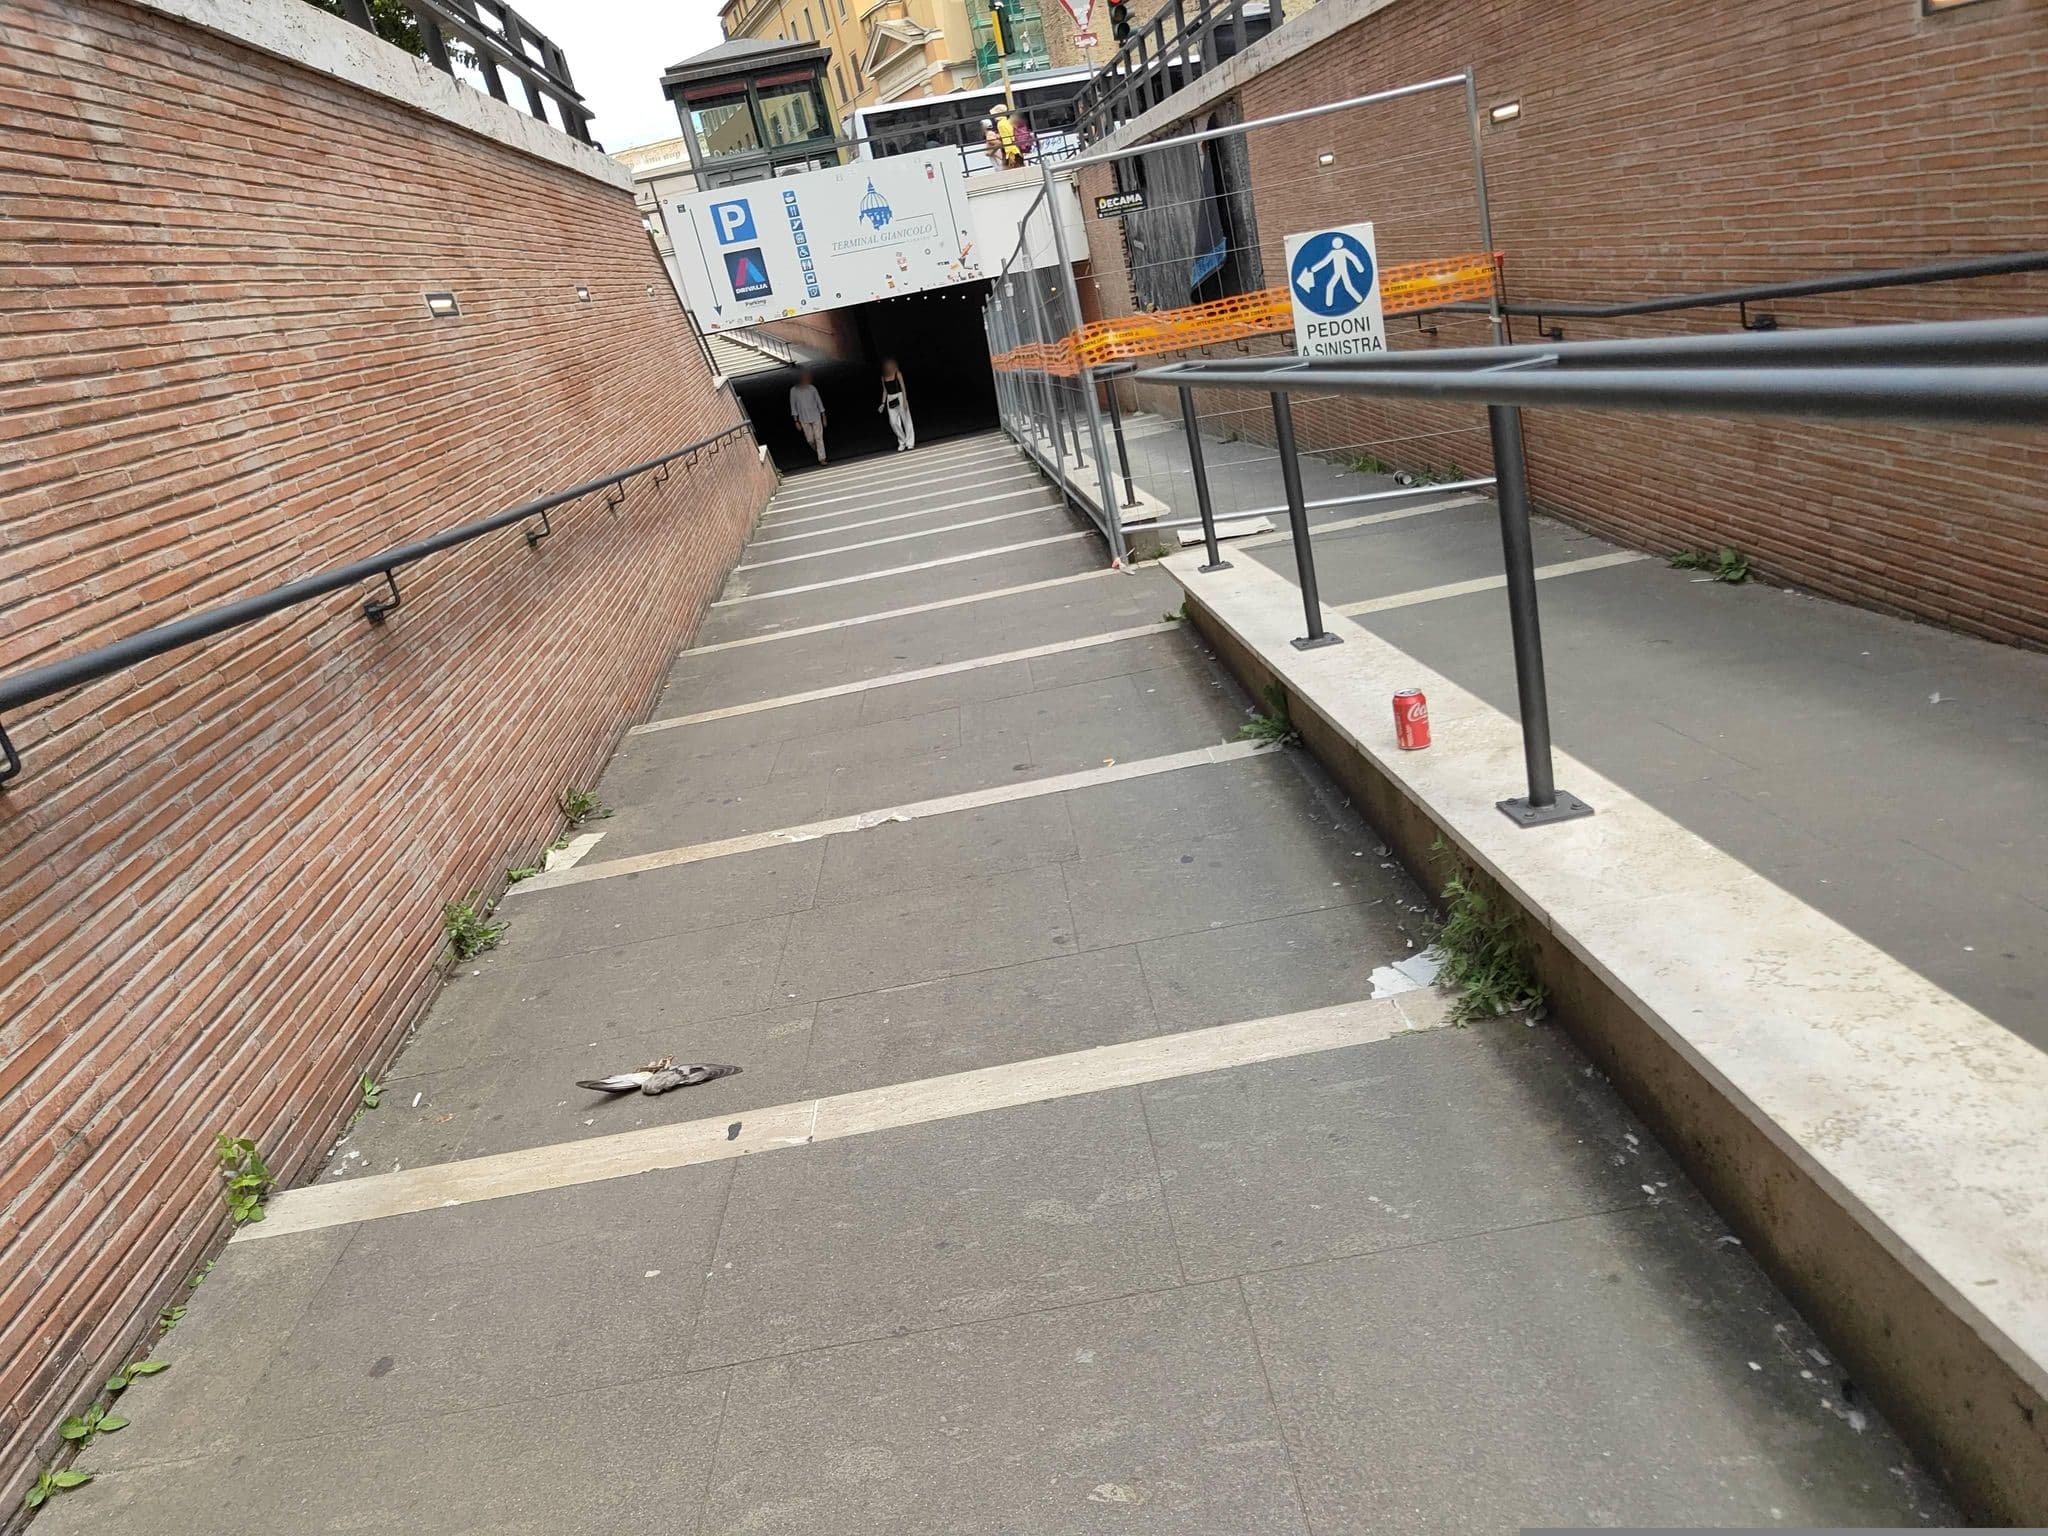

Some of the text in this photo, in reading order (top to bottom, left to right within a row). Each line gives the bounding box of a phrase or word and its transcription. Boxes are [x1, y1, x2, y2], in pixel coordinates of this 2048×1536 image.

[1098, 193, 1143, 210] DECAMA
[718, 204, 746, 241] P
[832, 235, 880, 251] TERMINAL
[880, 224, 933, 241] GIANICOLO
[735, 283, 768, 295] DRIVALIA
[745, 299, 767, 307] Parking
[1307, 316, 1371, 339] PEDONI
[1303, 335, 1383, 357] A SINISTRA
